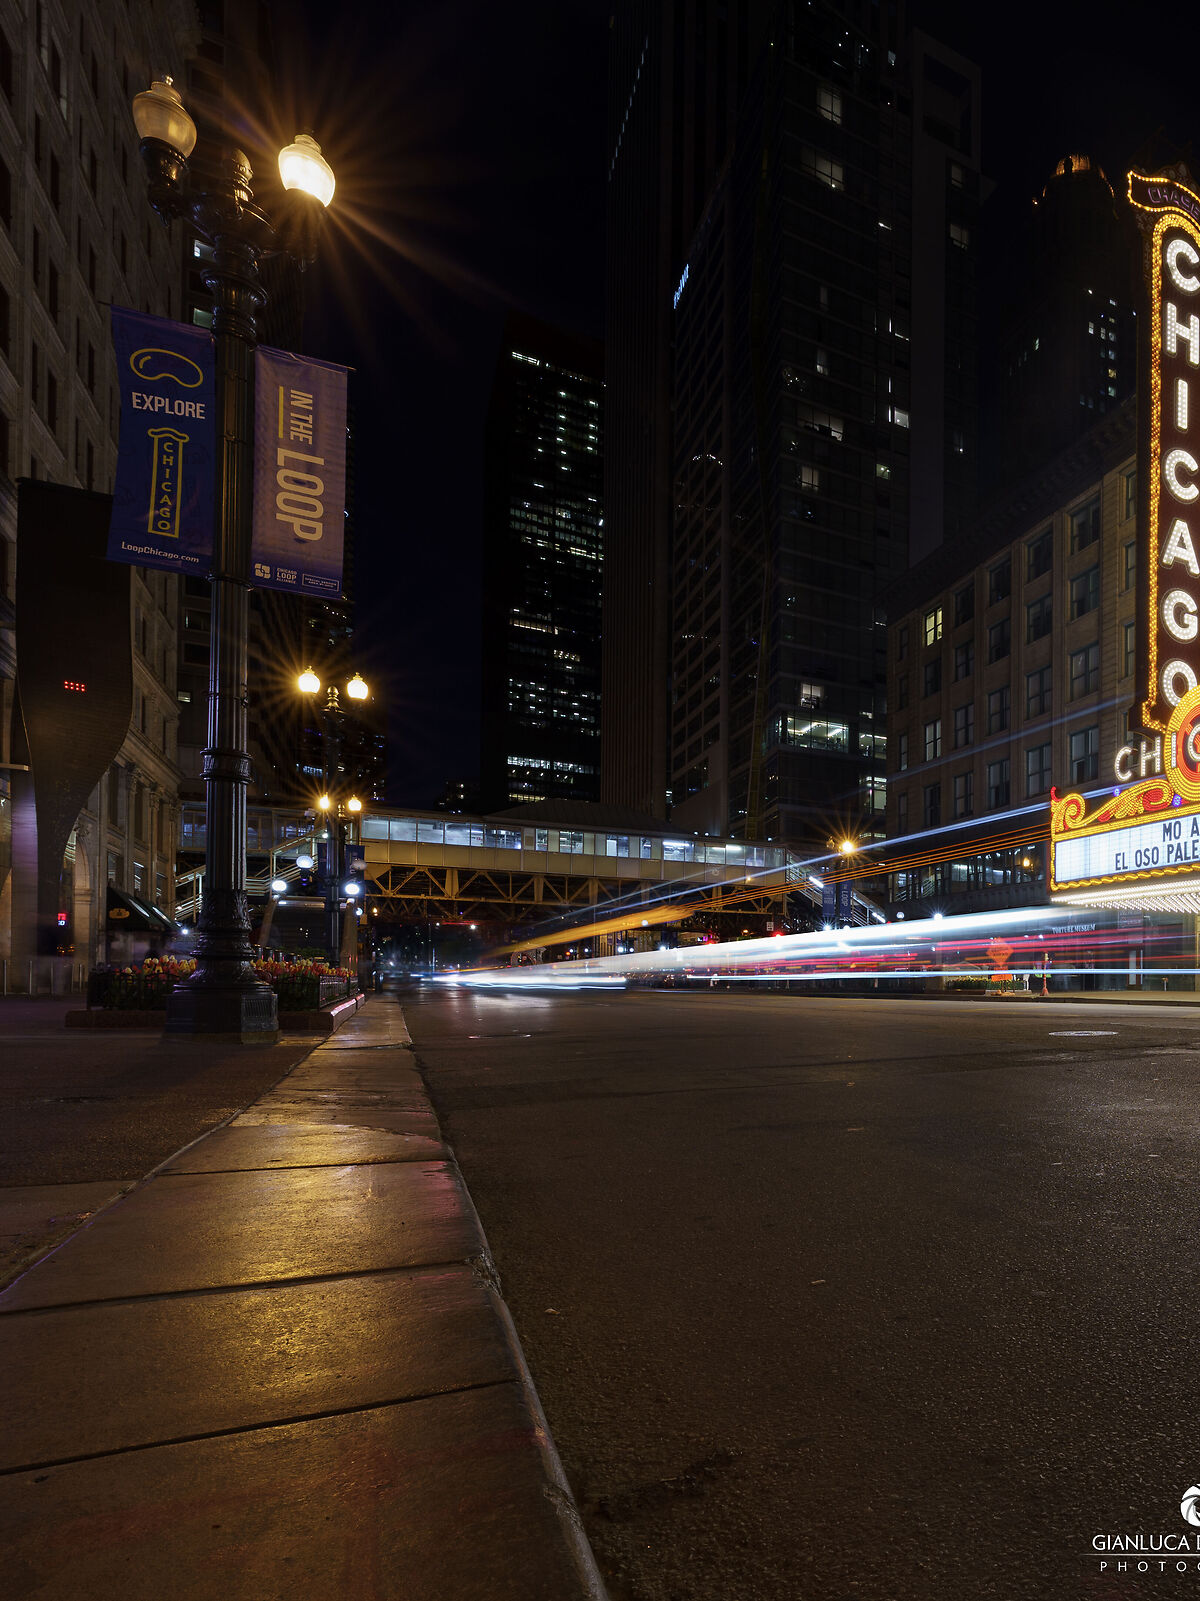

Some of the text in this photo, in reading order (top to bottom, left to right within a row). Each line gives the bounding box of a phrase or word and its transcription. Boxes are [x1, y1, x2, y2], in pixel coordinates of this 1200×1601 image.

[132, 392, 205, 419] EXPLORE
[275, 389, 325, 541] IN THE LOOP
[1162, 239, 1200, 706] CHICAGO
[157, 442, 174, 530] CHICAGO
[121, 541, 200, 563] LoopChicago.com
[276, 572, 297, 580] LOOP
[1162, 820, 1181, 842] MO
[1115, 852, 1128, 871] EL
[1135, 846, 1159, 868] OSO
